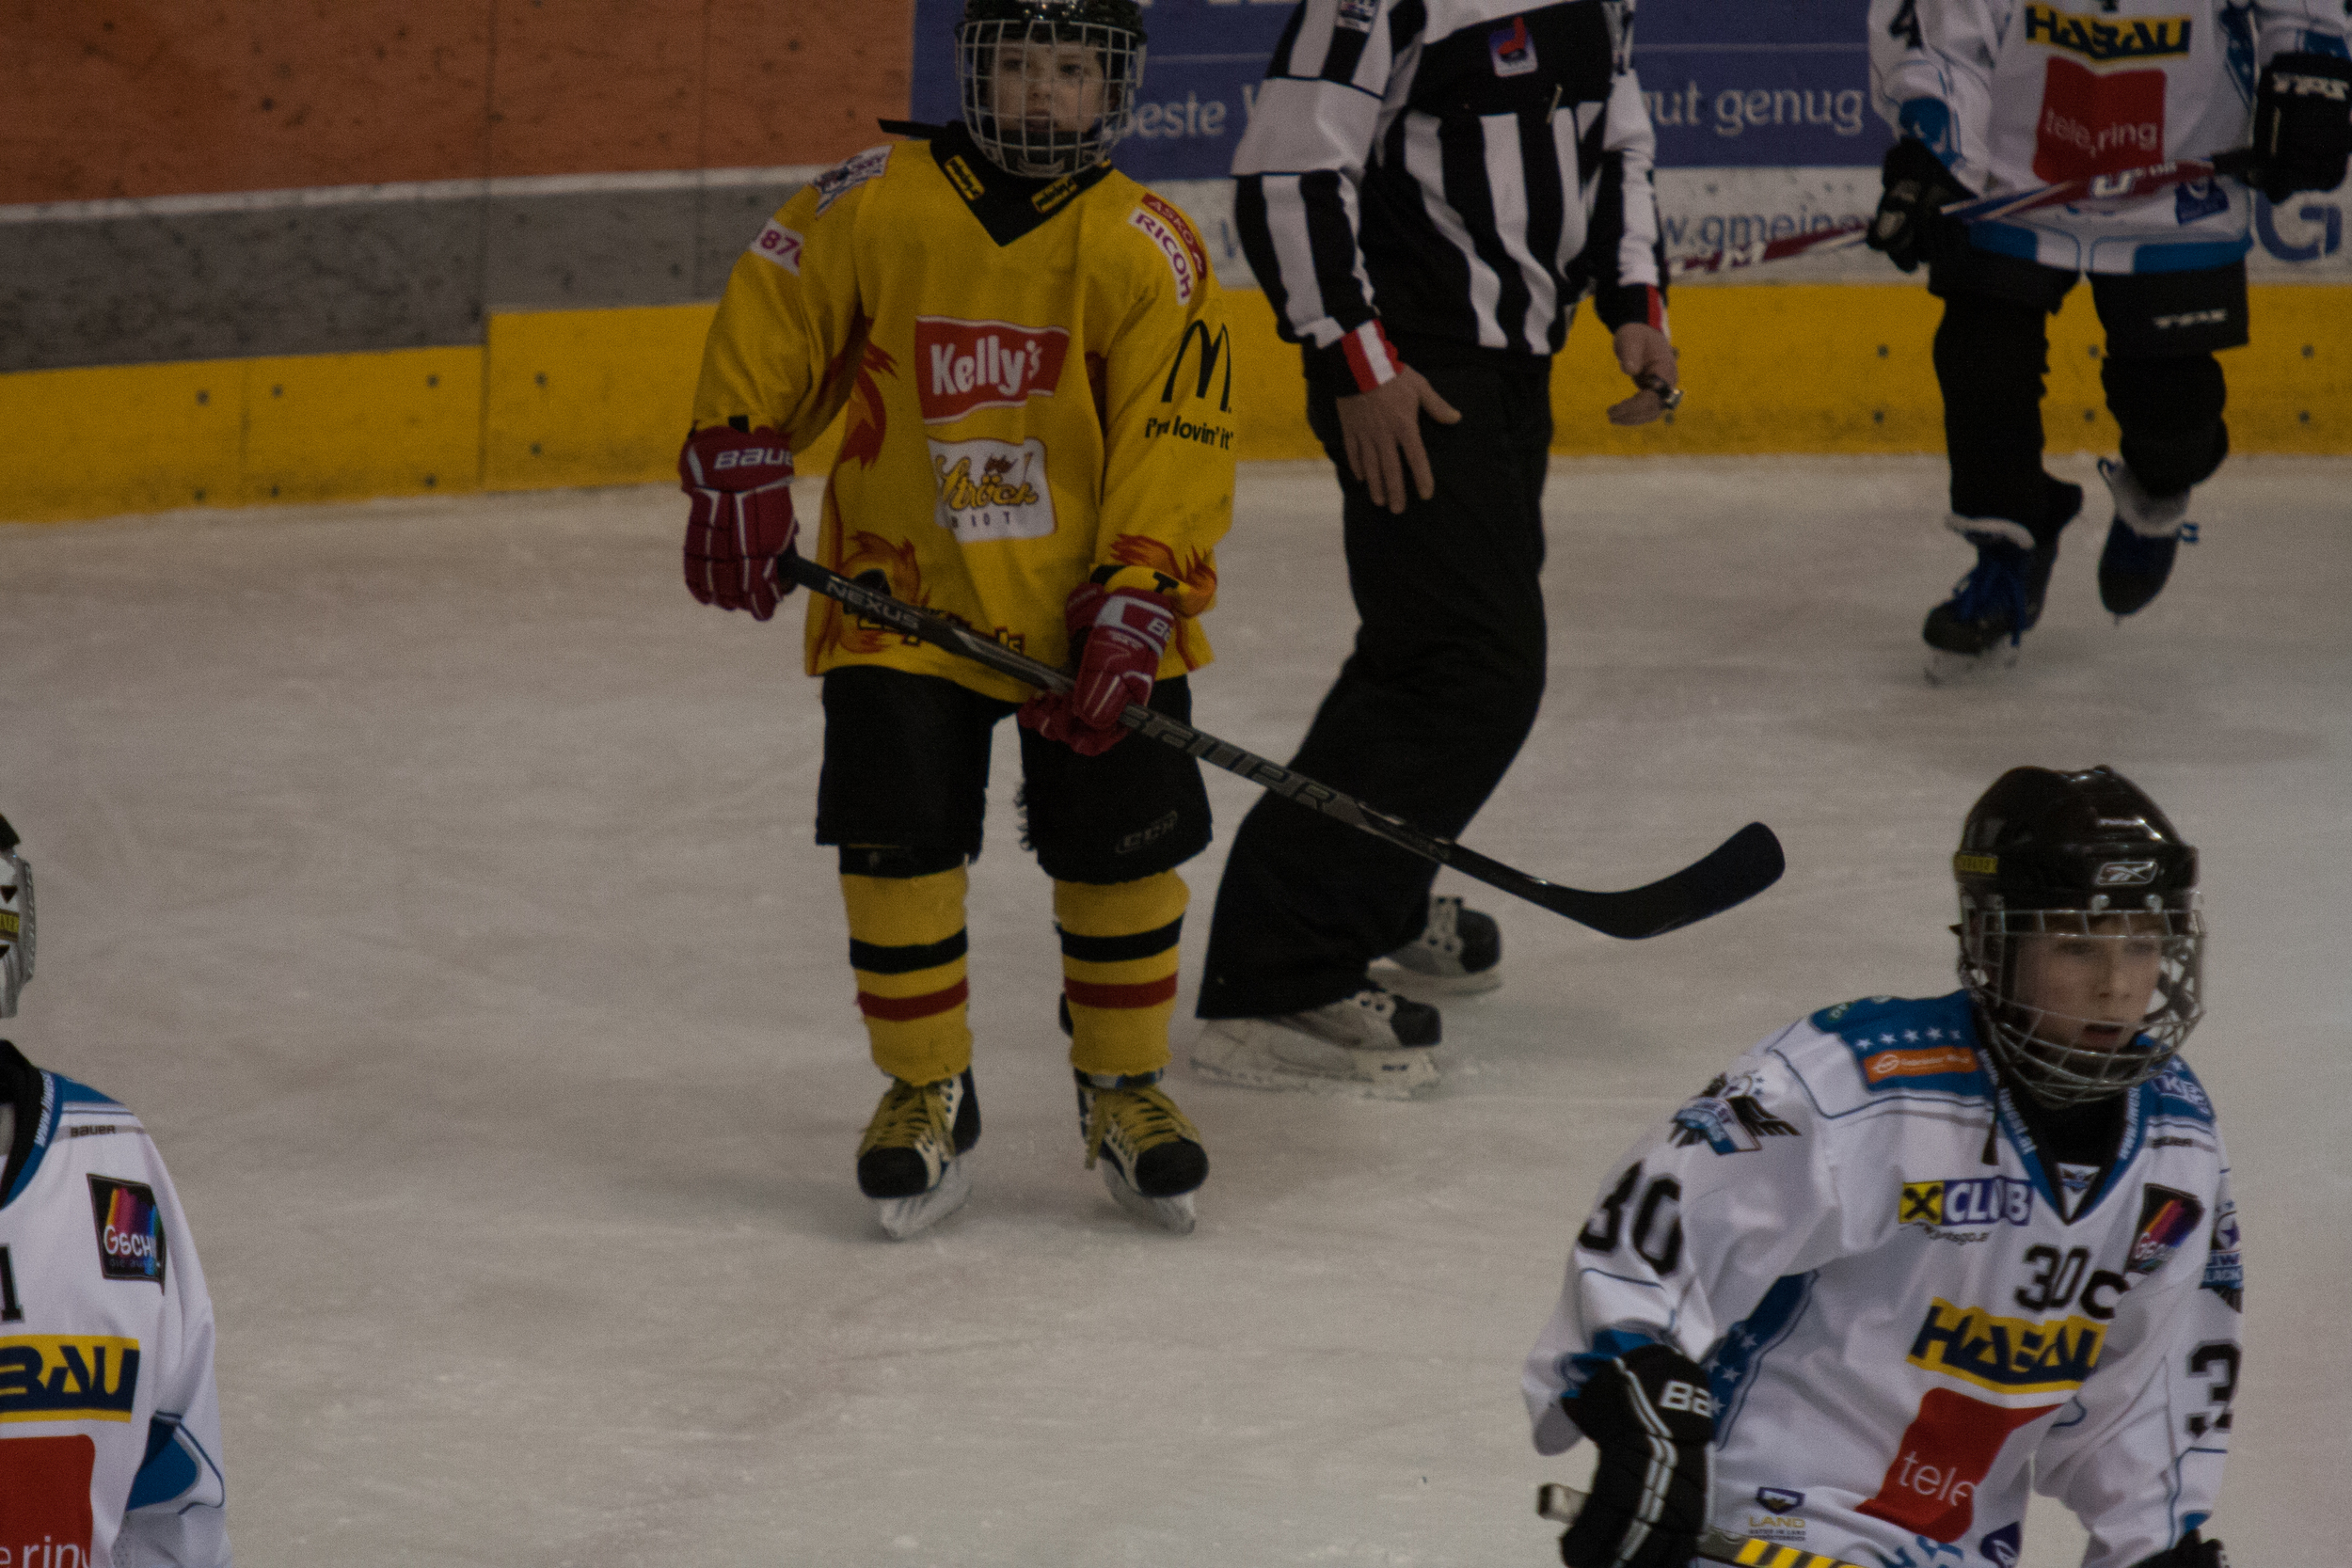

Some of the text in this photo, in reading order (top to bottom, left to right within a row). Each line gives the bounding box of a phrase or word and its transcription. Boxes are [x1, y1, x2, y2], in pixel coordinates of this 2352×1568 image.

[2025, 6, 2191, 60] HABAU
[1646, 80, 1864, 136] ut genug
[1135, 213, 1192, 299] RICOH
[930, 334, 1042, 396] Kelly's
[2014, 1244, 2090, 1311] 30
